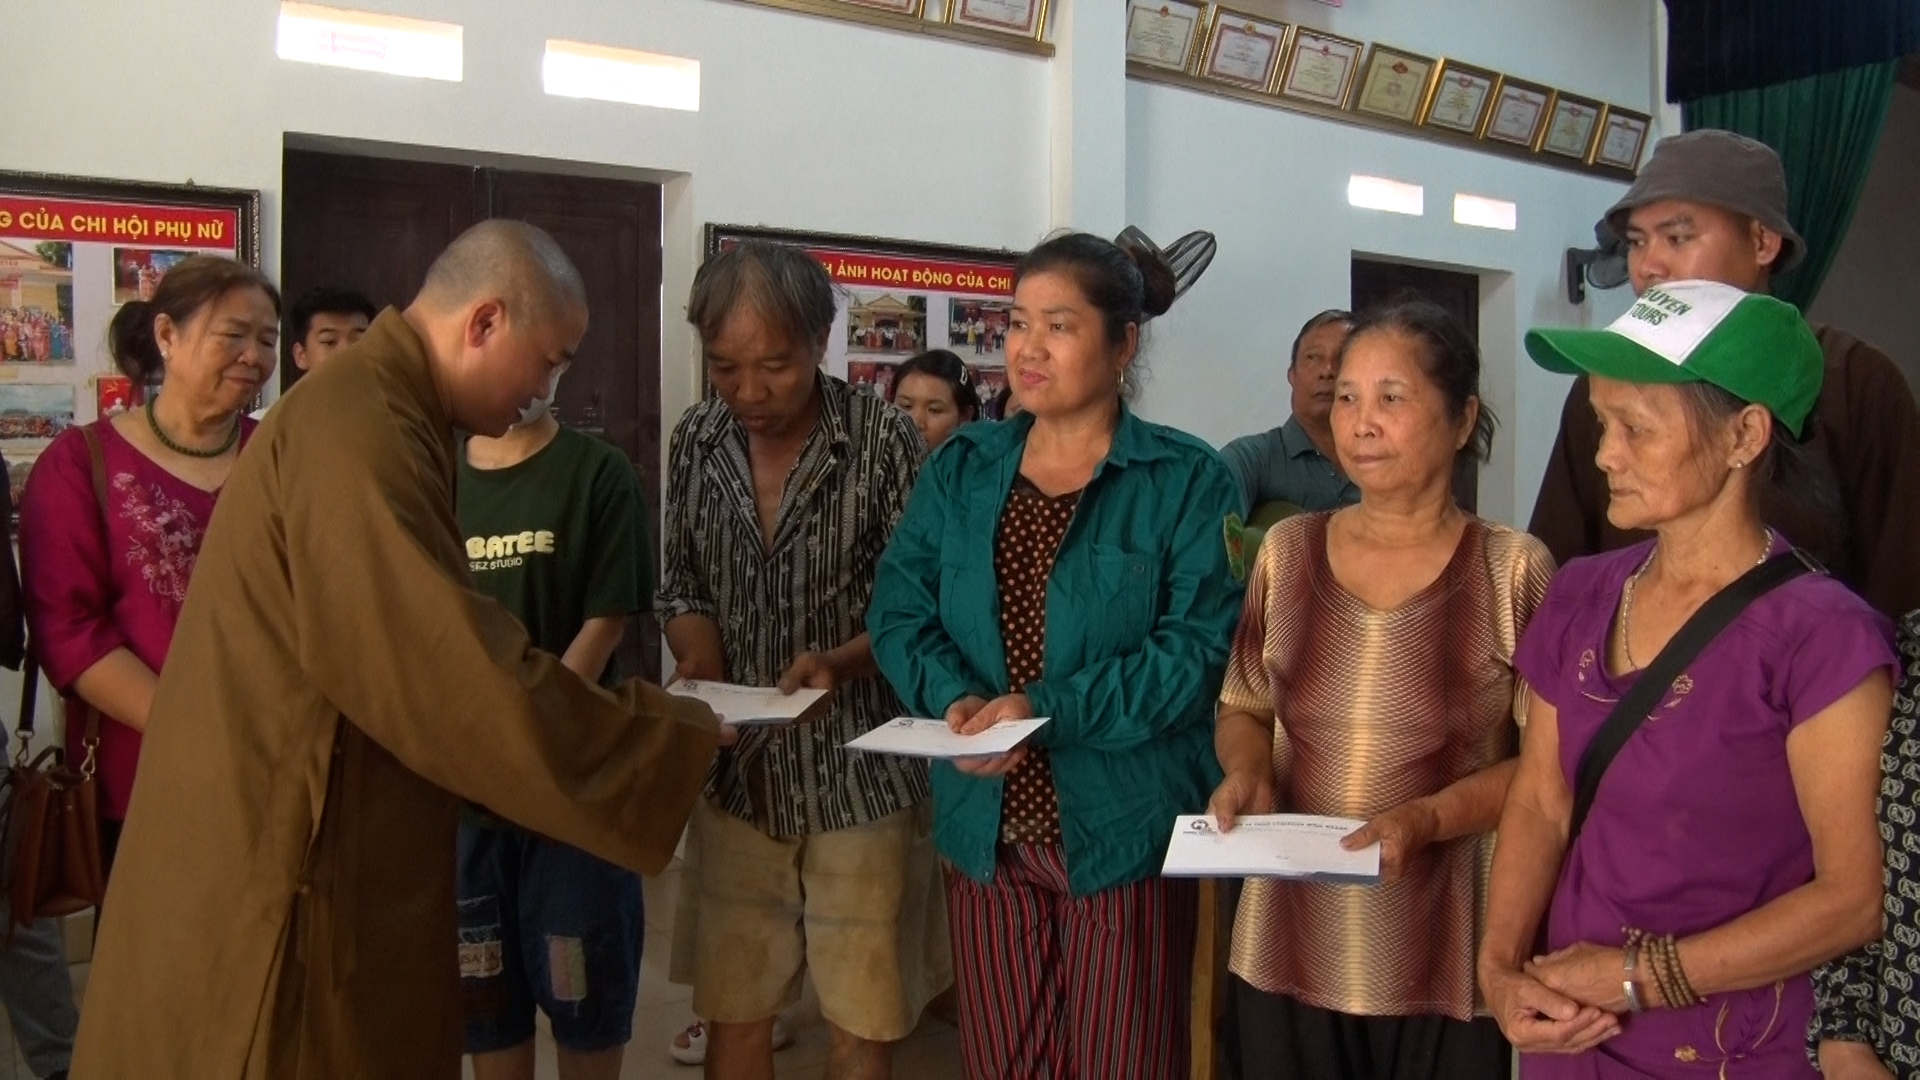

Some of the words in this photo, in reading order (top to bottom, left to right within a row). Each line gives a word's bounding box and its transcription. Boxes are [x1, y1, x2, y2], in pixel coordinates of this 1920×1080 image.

[19, 207, 64, 231] CỦA
[71, 215, 107, 233] CHI
[113, 214, 148, 239] HỘI
[155, 221, 191, 242] PHỤ
[198, 219, 224, 240] NỮ
[836, 260, 867, 278] ẢNH
[871, 267, 908, 284] HOẠT
[912, 267, 952, 288] ĐỘNG
[956, 270, 984, 288] CỦA
[988, 277, 1010, 290] CHI
[465, 530, 555, 559] BATEE
[489, 557, 523, 570] STUDIO
